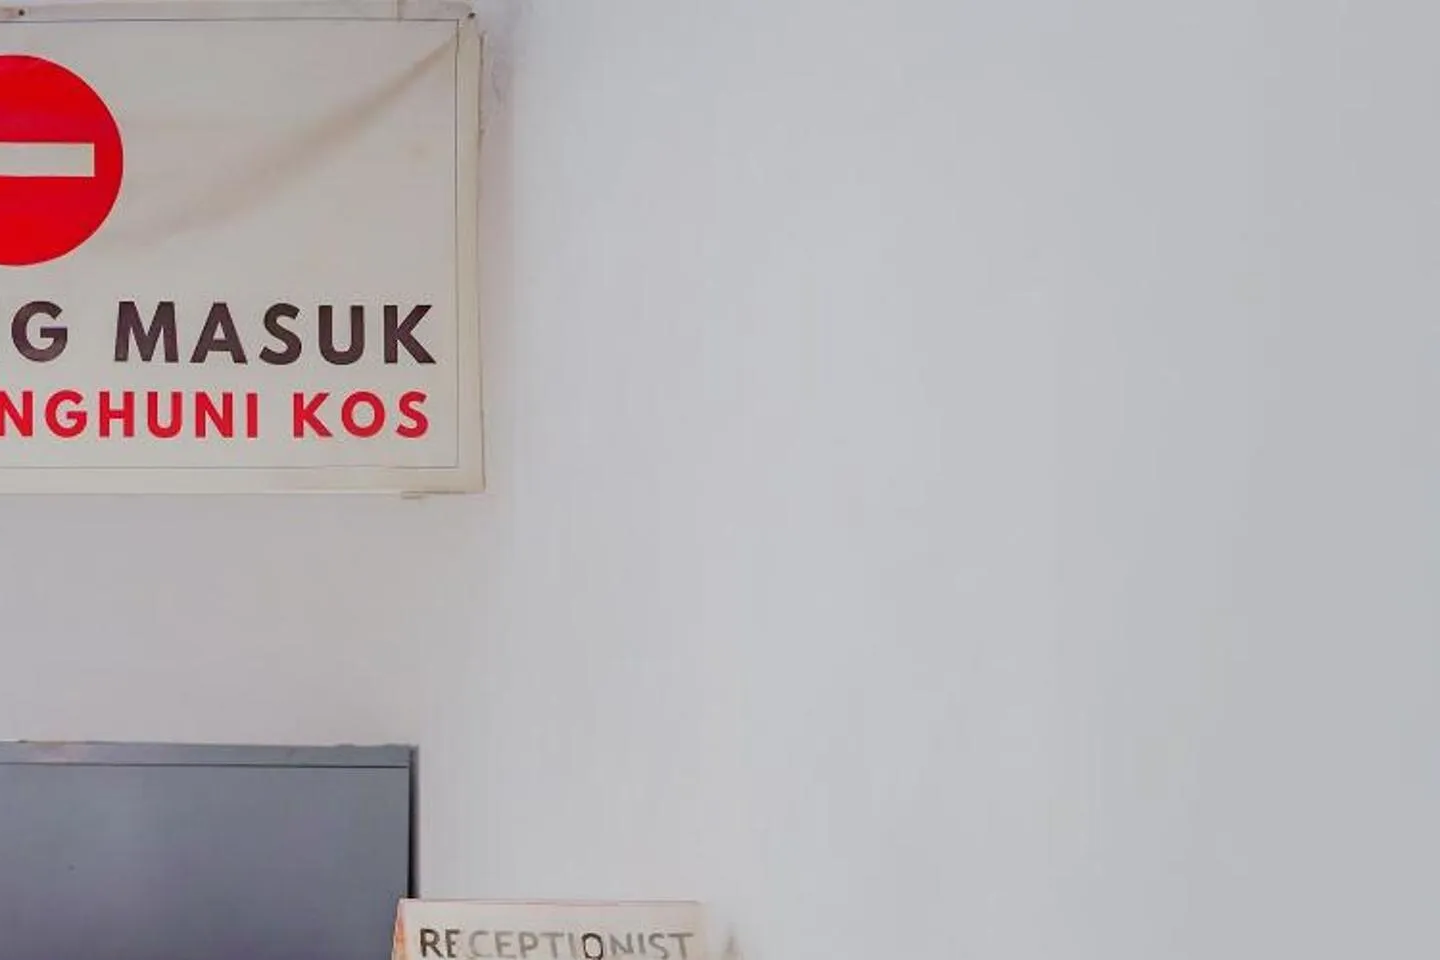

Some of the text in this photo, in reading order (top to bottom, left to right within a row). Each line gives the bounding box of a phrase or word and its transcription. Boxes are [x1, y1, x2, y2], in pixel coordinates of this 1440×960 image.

[113, 301, 436, 366] MASUK
[292, 391, 430, 439] KOS
[418, 928, 694, 960] RECEPTIONIST
